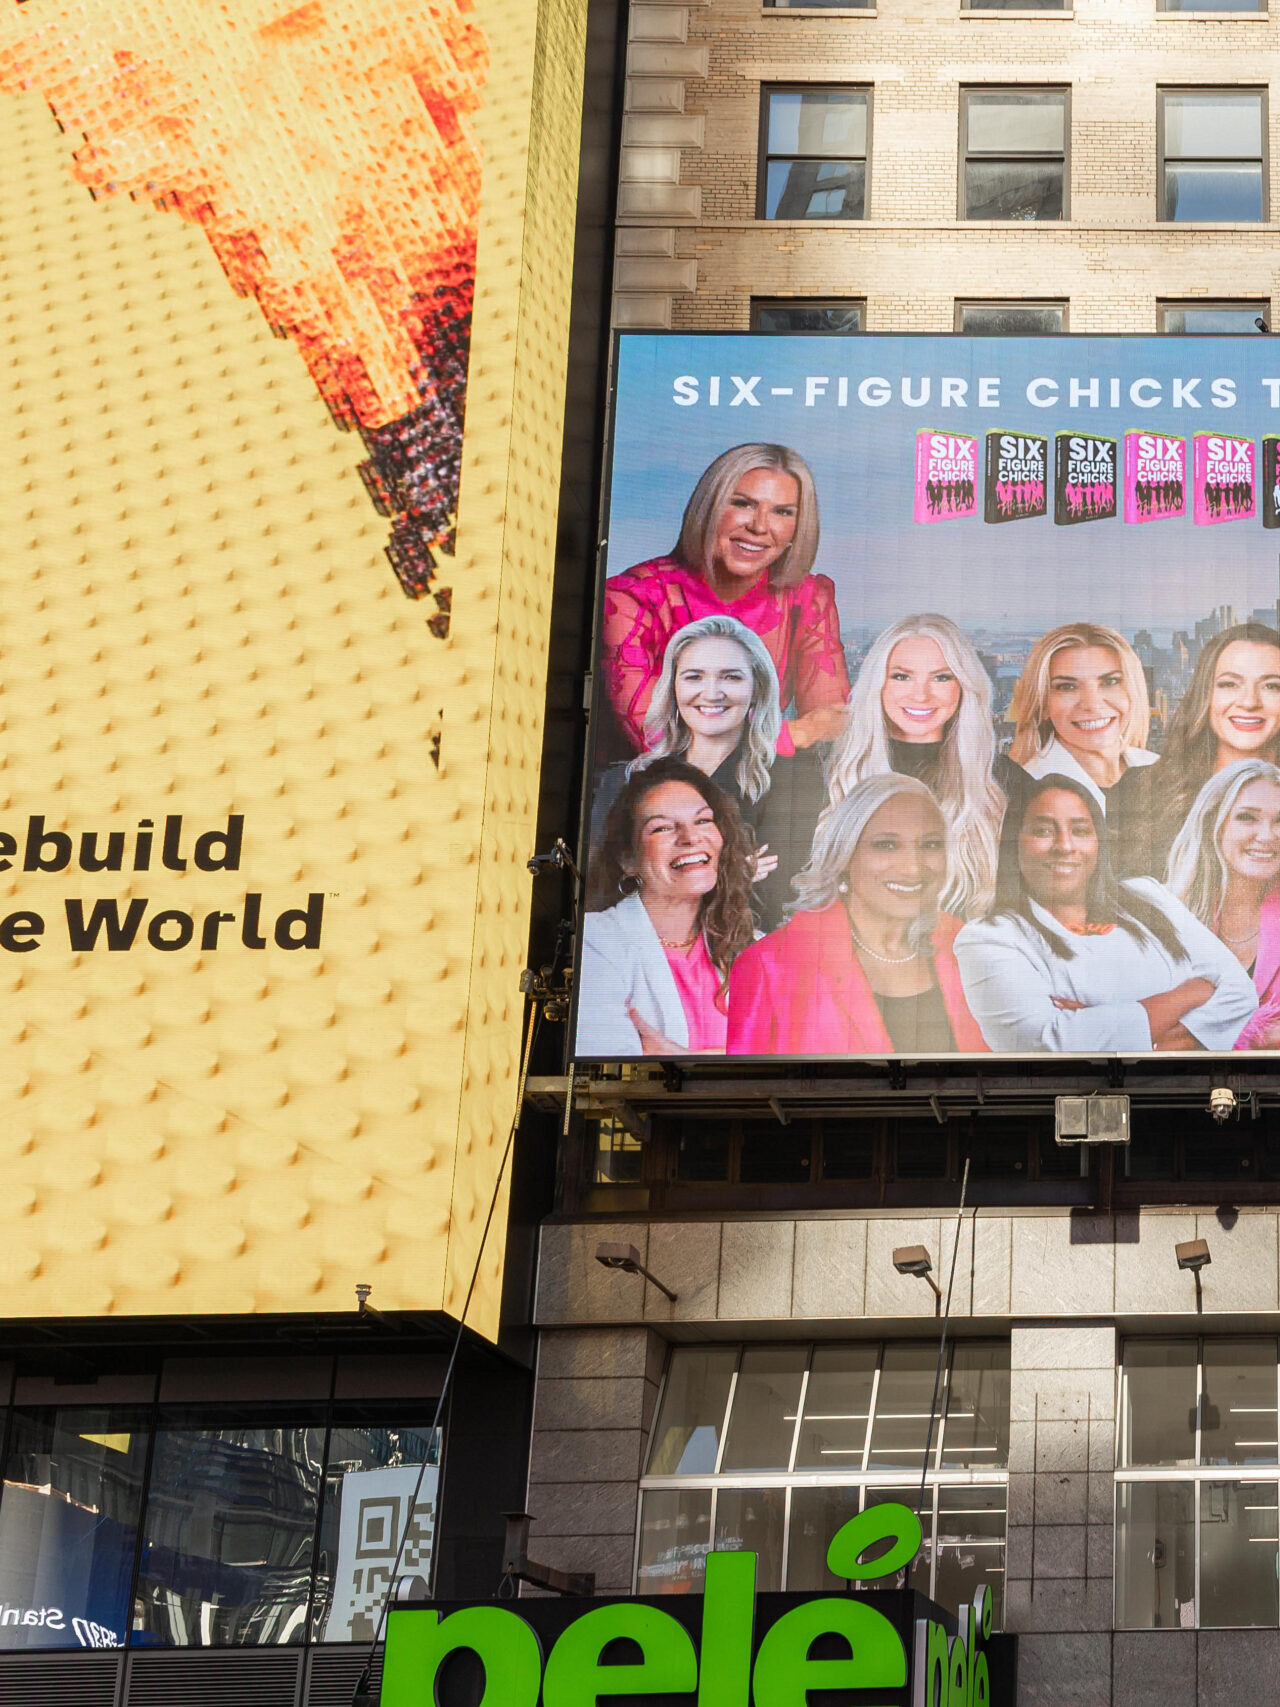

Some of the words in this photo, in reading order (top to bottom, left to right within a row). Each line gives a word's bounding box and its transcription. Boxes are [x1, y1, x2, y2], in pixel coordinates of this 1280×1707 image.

[672, 375, 1001, 408] SIX-FIGURE
[1025, 377, 1237, 408] CHICKS
[928, 459, 974, 472] FIGURE
[998, 459, 1044, 472] FIGURE
[1068, 461, 1114, 473] FIGURE
[1137, 459, 1182, 472] FIGURE
[1206, 461, 1251, 474] FIGURE
[928, 471, 974, 482] CHICKS
[998, 471, 1044, 482] CHICKS
[1068, 472, 1114, 484] CHICKS
[1137, 471, 1182, 482] CHICKS
[1206, 472, 1251, 484] CHICKS
